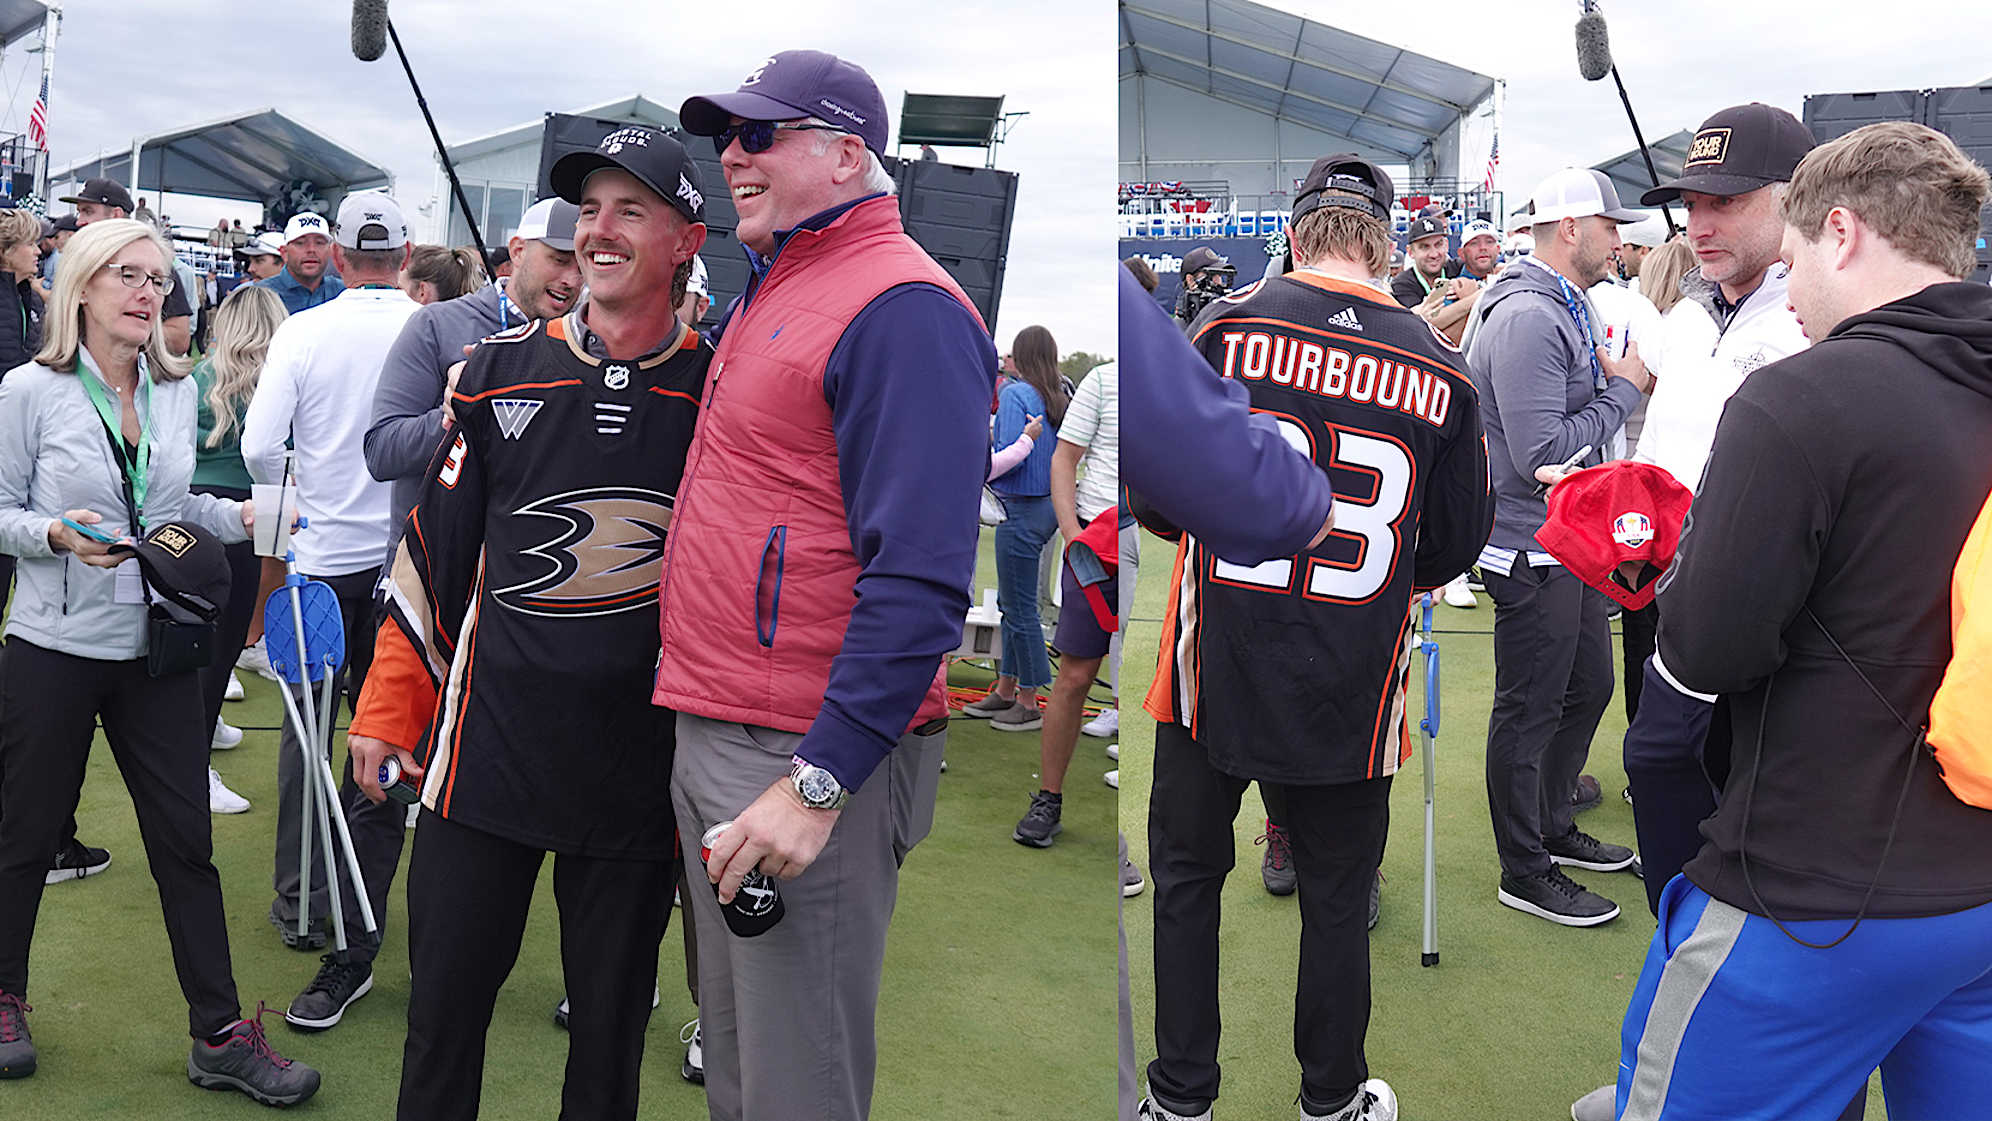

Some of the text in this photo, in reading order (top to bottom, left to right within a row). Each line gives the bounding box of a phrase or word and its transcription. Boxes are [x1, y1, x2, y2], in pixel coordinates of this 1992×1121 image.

[1692, 136, 1722, 151] TOUR
[1327, 315, 1364, 331] adidas
[1222, 331, 1451, 428] TOURBOUND
